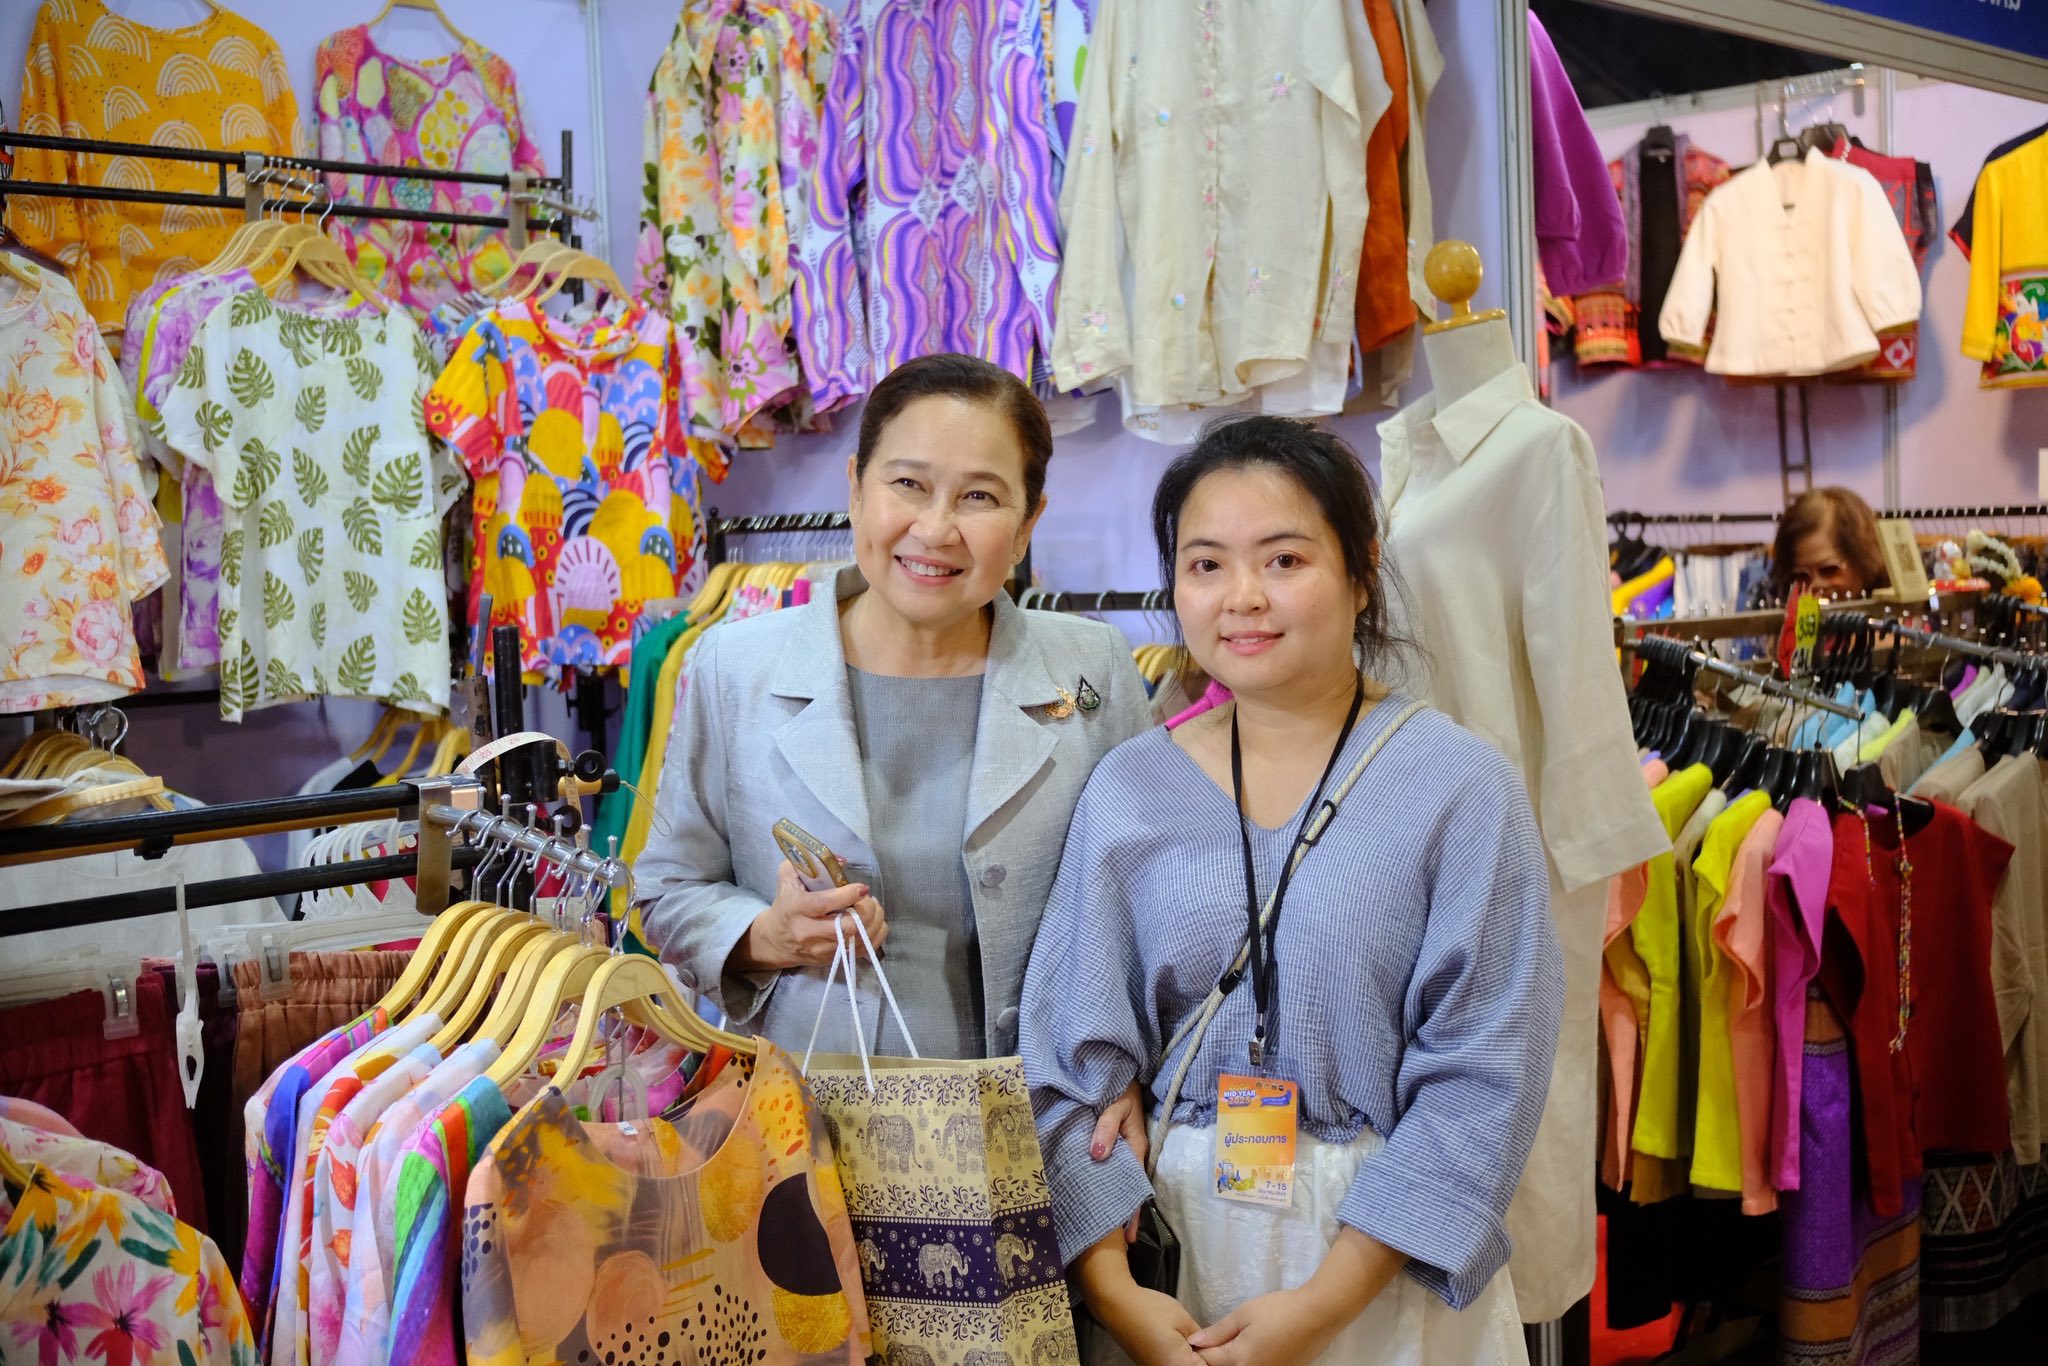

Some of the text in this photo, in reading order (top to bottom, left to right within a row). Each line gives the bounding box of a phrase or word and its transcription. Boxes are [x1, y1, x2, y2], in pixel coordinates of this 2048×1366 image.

[1228, 1097, 1251, 1105] 2025
[1224, 1132, 1287, 1147] ผู้ประกอบการ
